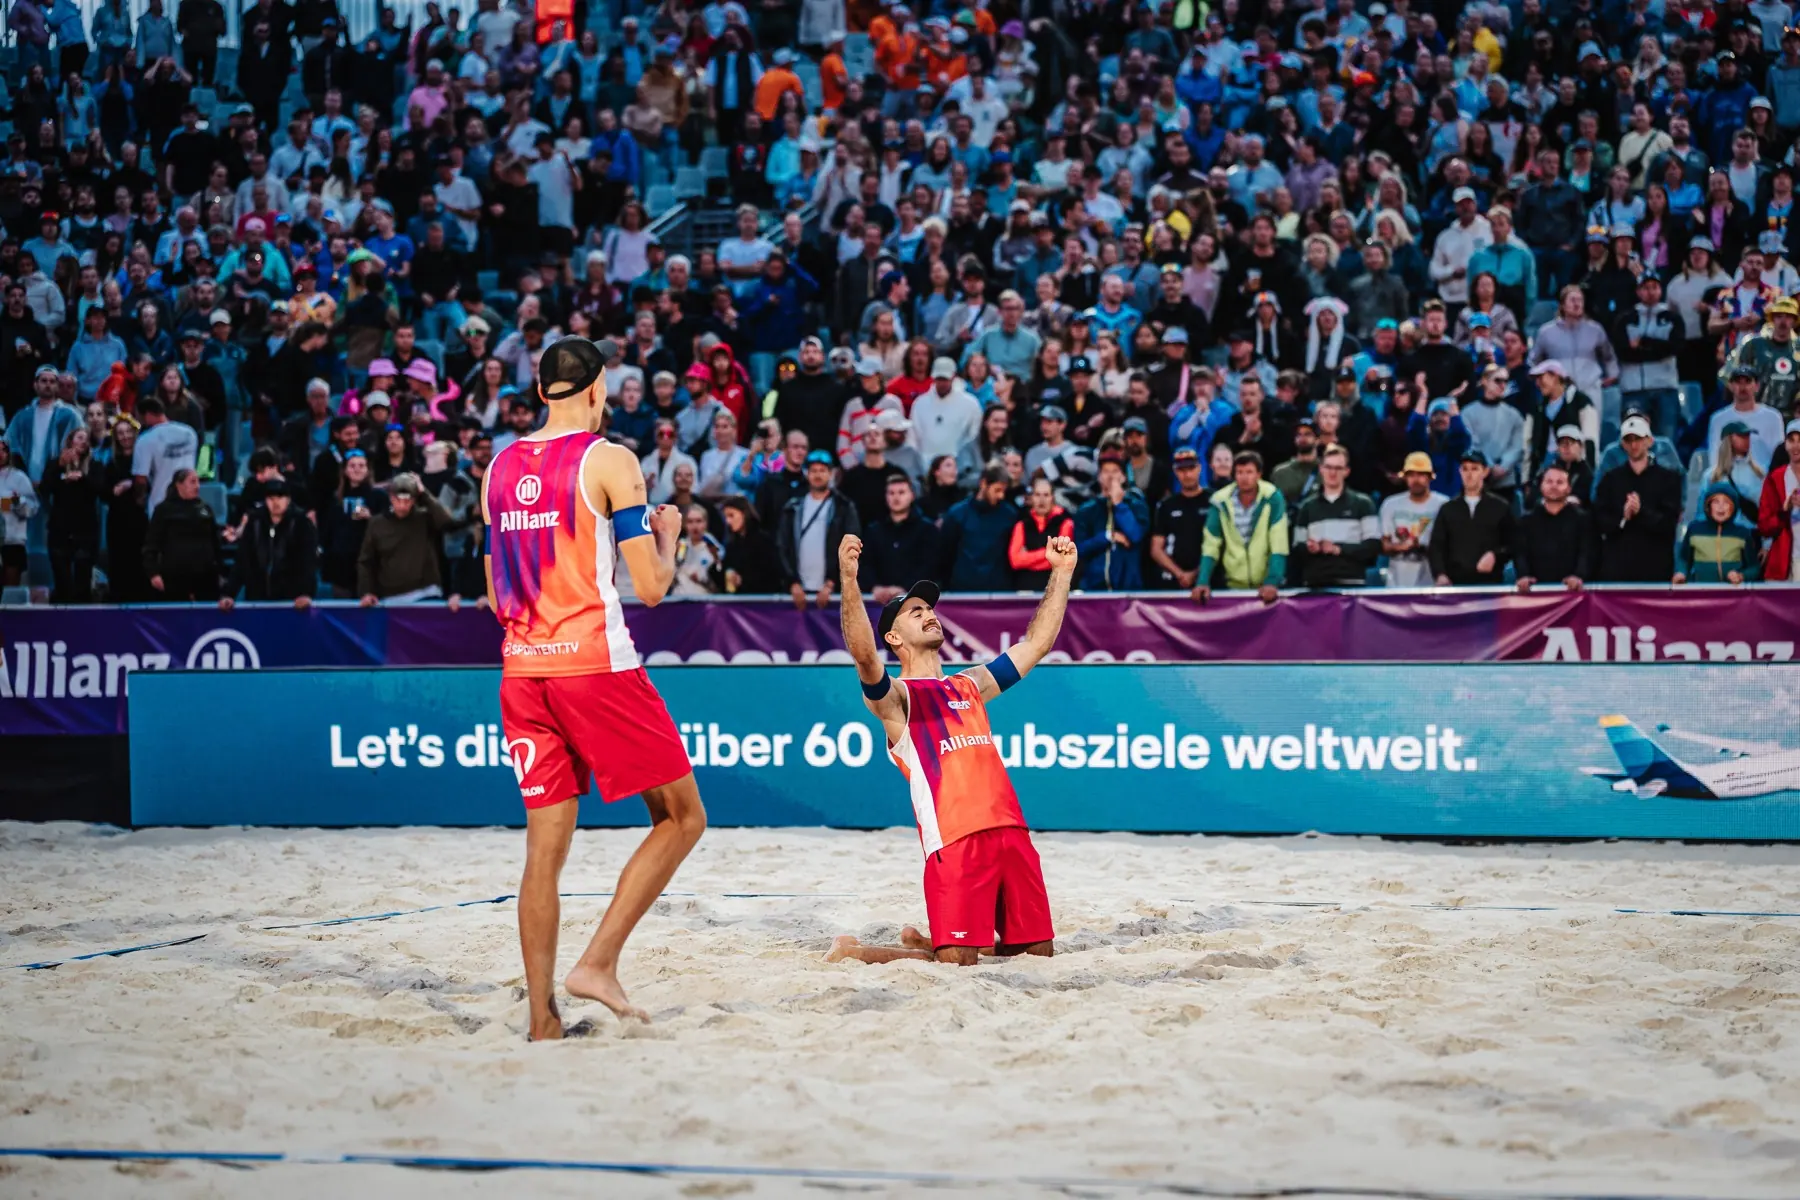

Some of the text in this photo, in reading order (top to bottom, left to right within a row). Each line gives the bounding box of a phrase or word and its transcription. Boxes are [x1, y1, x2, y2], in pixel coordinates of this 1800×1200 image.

[500, 509, 560, 533] Allianz
[331, 724, 445, 767] Let’s
[680, 723, 793, 767] über
[803, 722, 873, 768] 60
[886, 723, 1211, 769] ubsziele
[1221, 724, 1477, 771] weltweit.
[939, 734, 991, 756] Allianz
